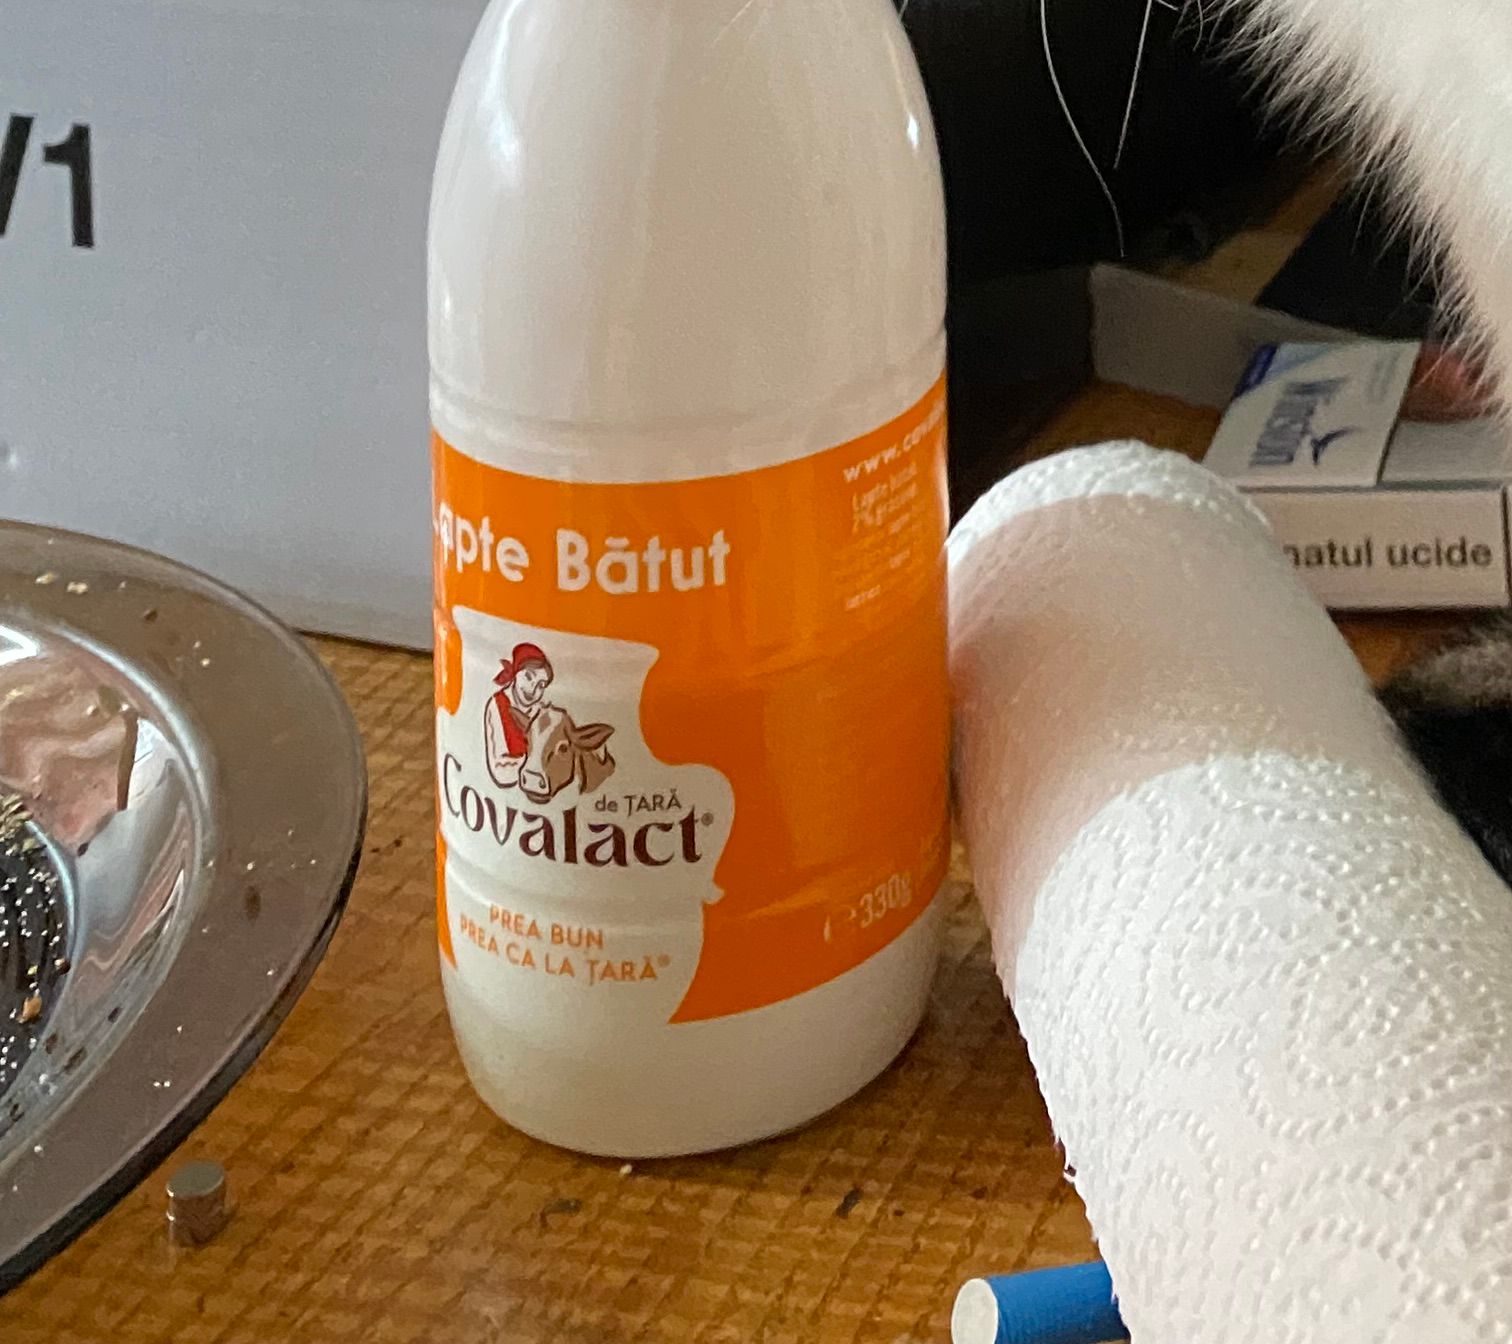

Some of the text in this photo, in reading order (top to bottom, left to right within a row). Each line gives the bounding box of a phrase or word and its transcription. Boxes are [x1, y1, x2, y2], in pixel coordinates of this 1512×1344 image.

[432, 501, 731, 595] apte Bătut
[1387, 536, 1492, 567] ucide
[444, 753, 703, 867] Covalact
[595, 794, 618, 812] de
[460, 913, 499, 956] PREA
[506, 942, 535, 968] CA
[544, 953, 575, 978] LA
[490, 904, 604, 950] PREA BUN
